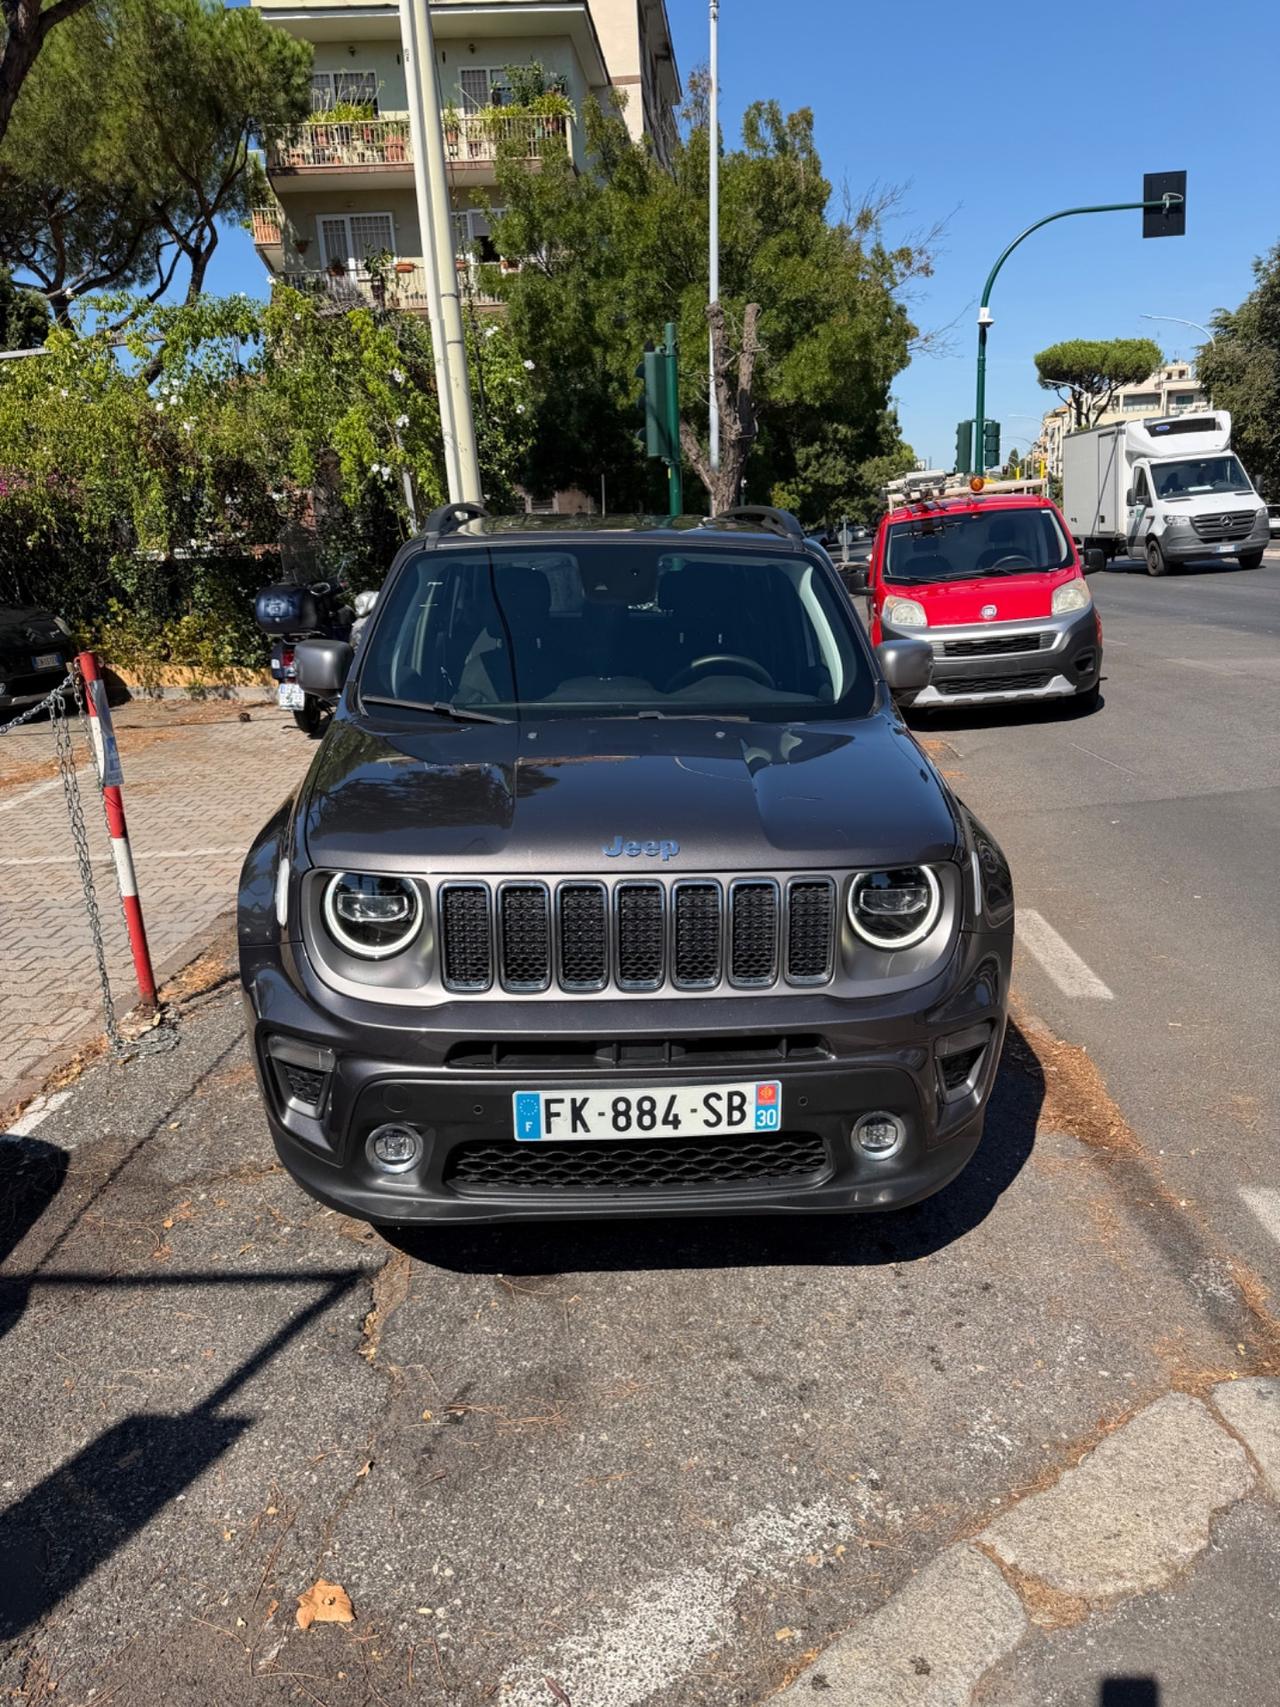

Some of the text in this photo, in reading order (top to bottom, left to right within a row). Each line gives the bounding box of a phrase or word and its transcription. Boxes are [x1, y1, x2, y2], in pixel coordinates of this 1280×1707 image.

[602, 835, 680, 861] Jeep
[544, 1090, 747, 1134] FK-884-SB
[756, 1109, 776, 1126] 30
[525, 1121, 533, 1132] F
